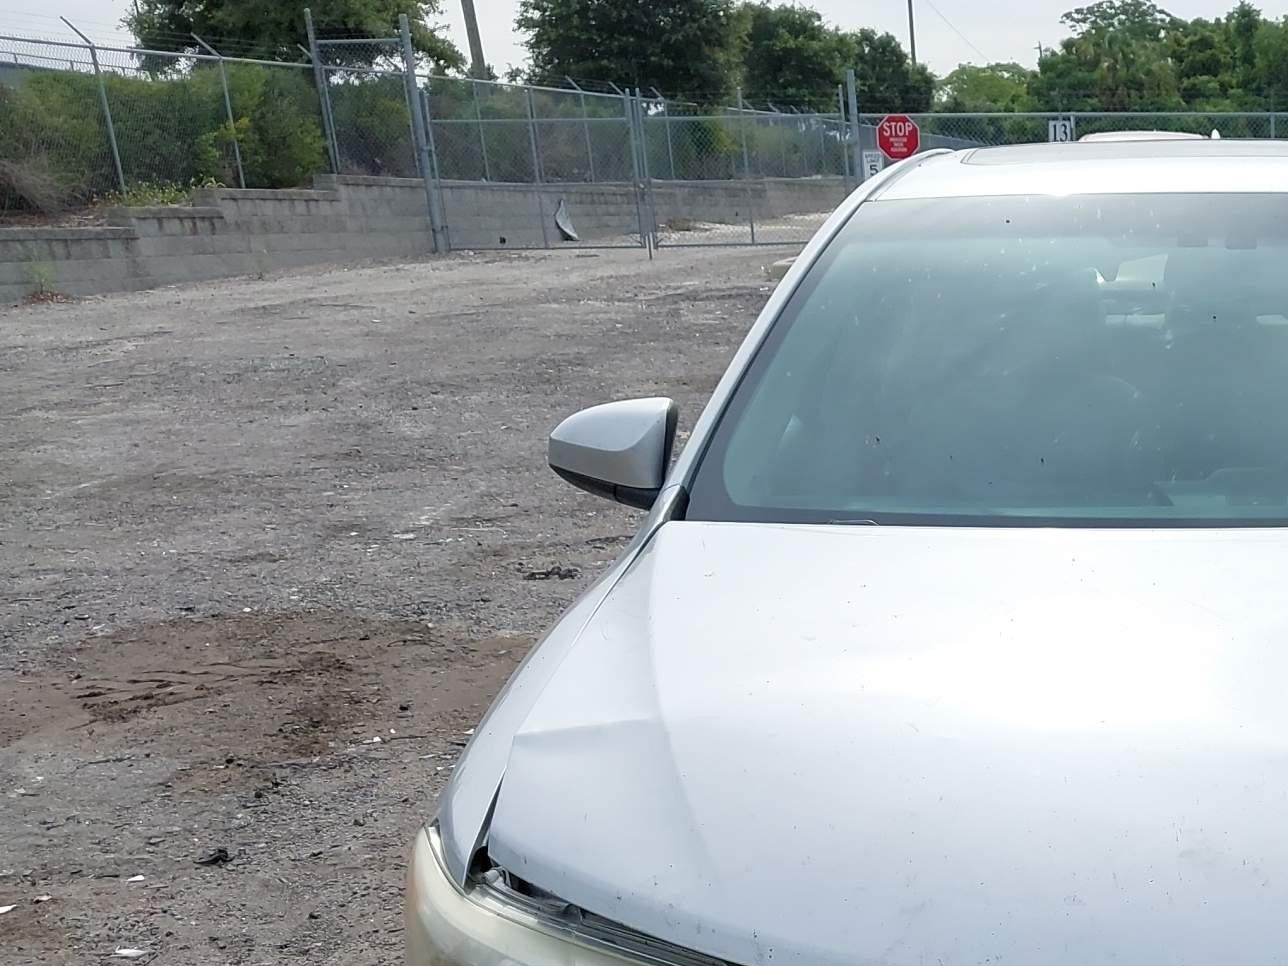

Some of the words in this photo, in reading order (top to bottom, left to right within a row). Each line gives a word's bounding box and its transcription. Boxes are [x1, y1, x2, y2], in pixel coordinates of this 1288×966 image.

[882, 121, 913, 137] STOP
[1052, 123, 1068, 142] 13
[869, 164, 879, 177] 5
